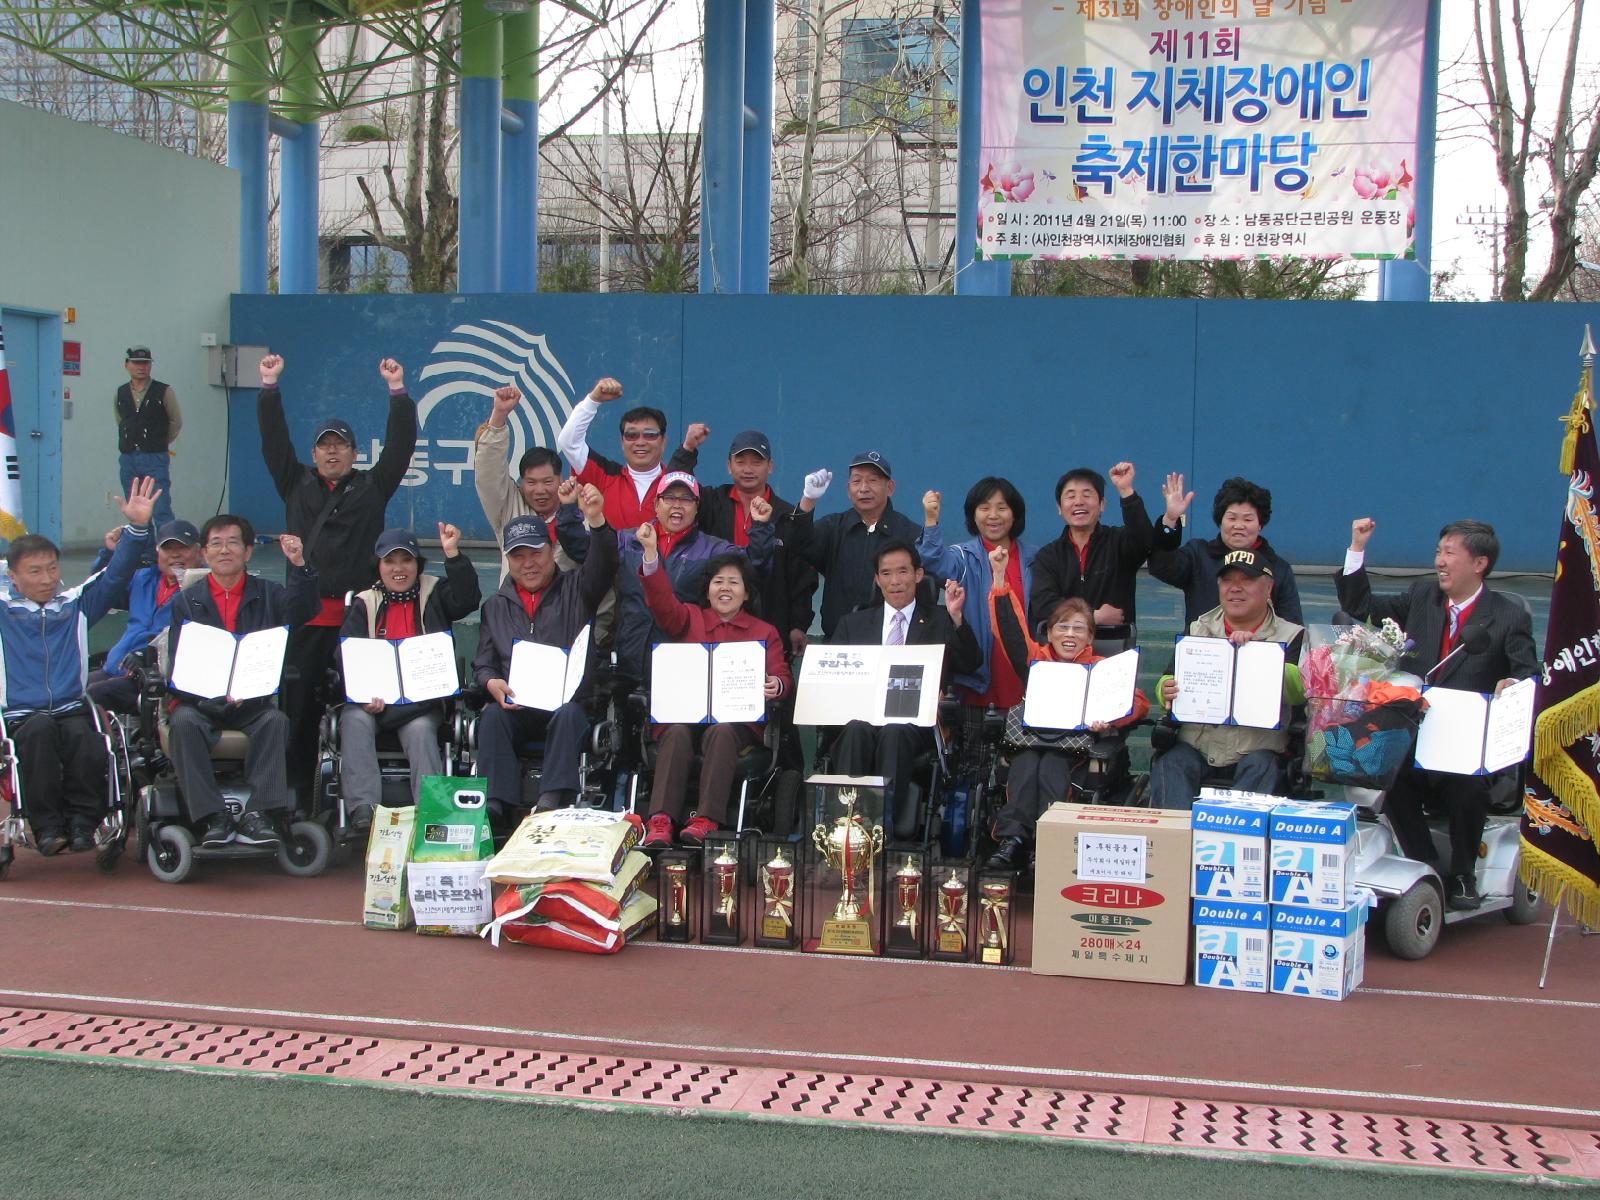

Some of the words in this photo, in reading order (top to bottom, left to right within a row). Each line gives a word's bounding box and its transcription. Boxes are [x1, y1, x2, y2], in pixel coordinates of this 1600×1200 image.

[1149, 27, 1241, 63] 제11회
[1022, 65, 1114, 125] 인천
[1126, 58, 1370, 126] 지체장애인
[1071, 130, 1318, 195] 축제한마당
[1033, 214, 1073, 227] 2011년
[1076, 214, 1096, 227] 4월
[1100, 214, 1147, 227] 21일(목)
[1152, 215, 1187, 227] 11:00
[1244, 211, 1353, 226] 남동공단근린공원
[1360, 210, 1401, 225] 운동장
[1243, 232, 1307, 247] 인천광역시
[1225, 550, 1255, 566] NYPD
[1196, 811, 1246, 826] Double
[1250, 818, 1261, 828] A
[1275, 822, 1326, 835] Double
[1331, 825, 1341, 836] A
[1199, 864, 1225, 872] Double
[1275, 870, 1301, 878] Double
[1082, 887, 1142, 906] 크리나
[1088, 914, 1134, 926] 미용티슈
[1198, 906, 1248, 920] Double
[1252, 911, 1262, 921] A
[1276, 912, 1326, 926] Double
[1331, 918, 1341, 928] A
[1276, 960, 1301, 968] Double
